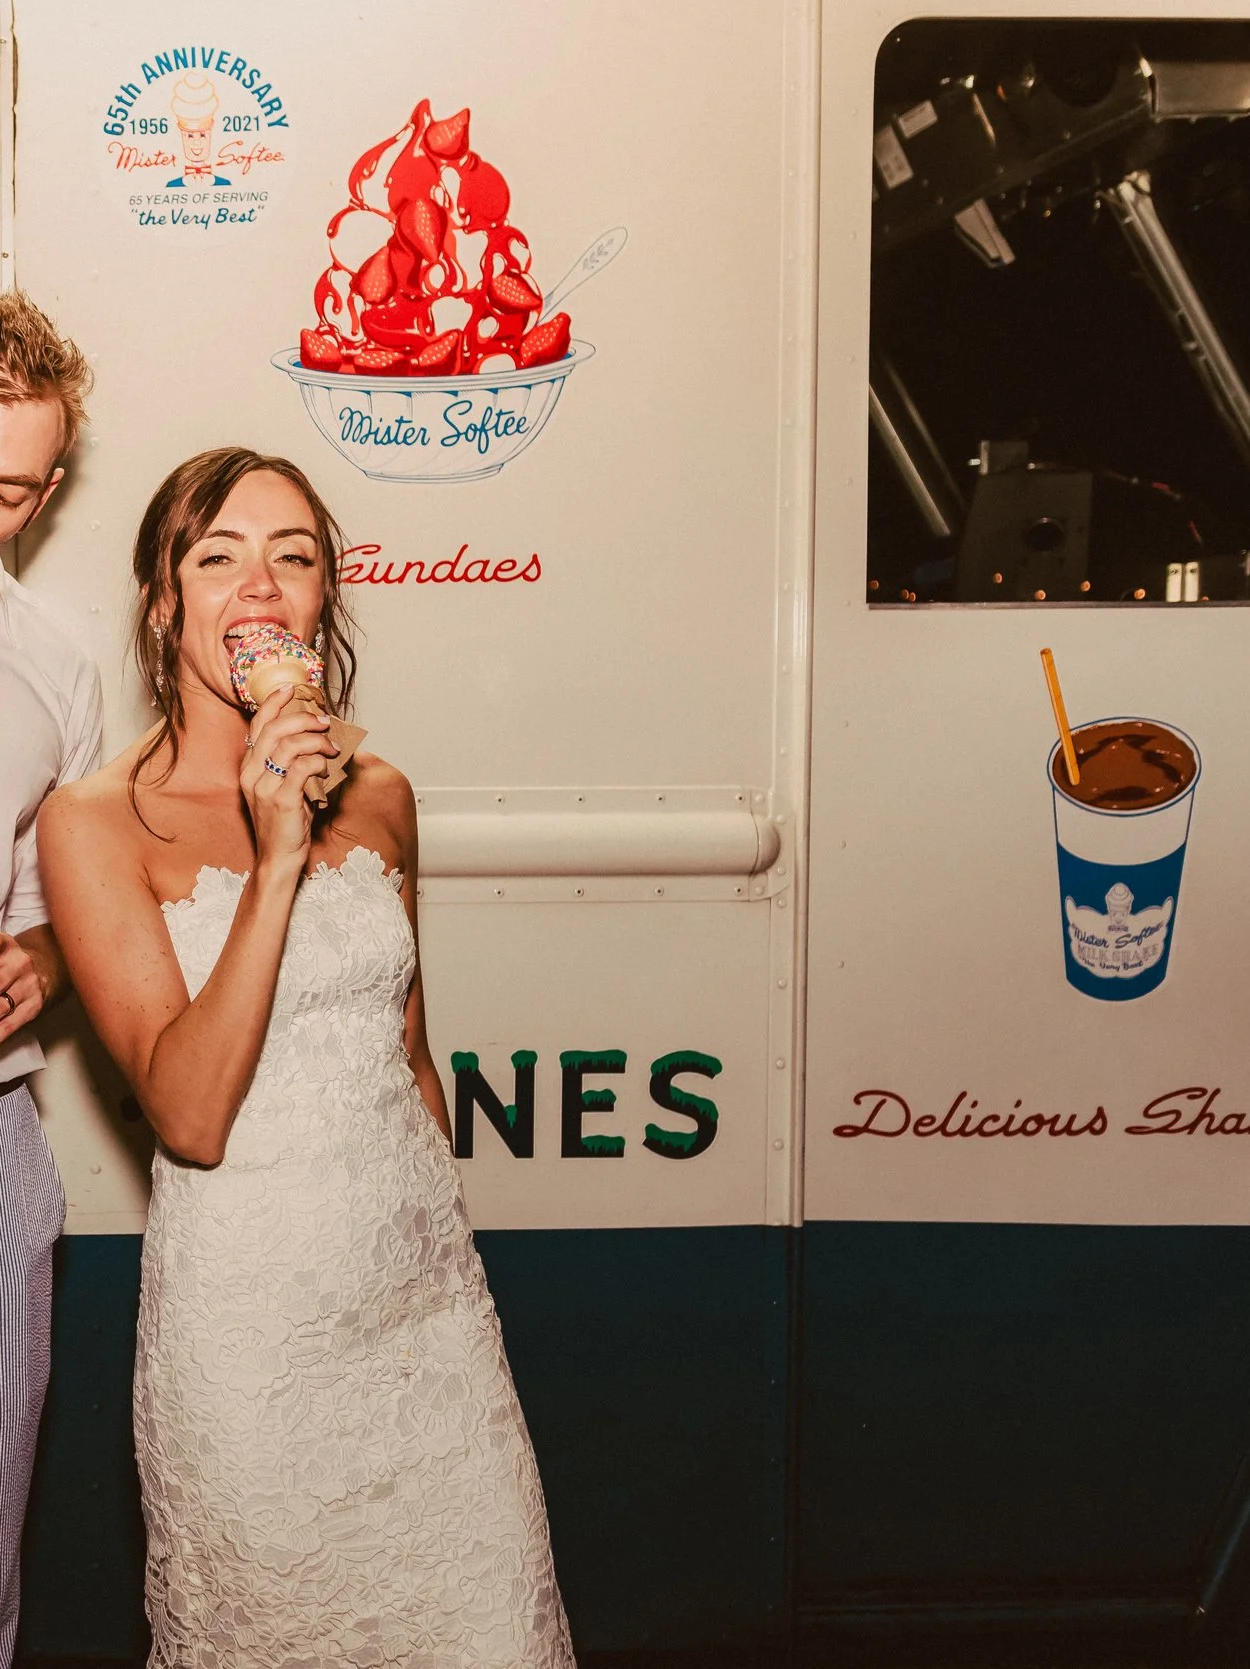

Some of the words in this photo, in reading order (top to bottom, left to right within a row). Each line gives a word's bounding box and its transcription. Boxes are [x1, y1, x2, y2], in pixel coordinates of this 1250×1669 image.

[103, 82, 142, 137] 65th
[141, 46, 290, 129] ANNIVERSARY
[128, 118, 169, 136] 1956
[222, 115, 261, 132] 2021
[107, 141, 178, 172] Mister
[215, 141, 286, 176] Softee
[129, 196, 143, 206] 65
[146, 194, 189, 205] YEARS
[192, 193, 210, 204] OF
[213, 191, 270, 204] SERVING
[171, 208, 211, 230] Very
[338, 406, 432, 447] Mister
[440, 399, 532, 454] Softee
[1071, 923, 1110, 948] Mister
[1114, 921, 1164, 949] Softee
[1077, 944, 1109, 962] MILK
[1111, 944, 1160, 962] SHAKE
[832, 1089, 1110, 1139] Delicious
[1123, 1086, 1250, 1137] Sha
